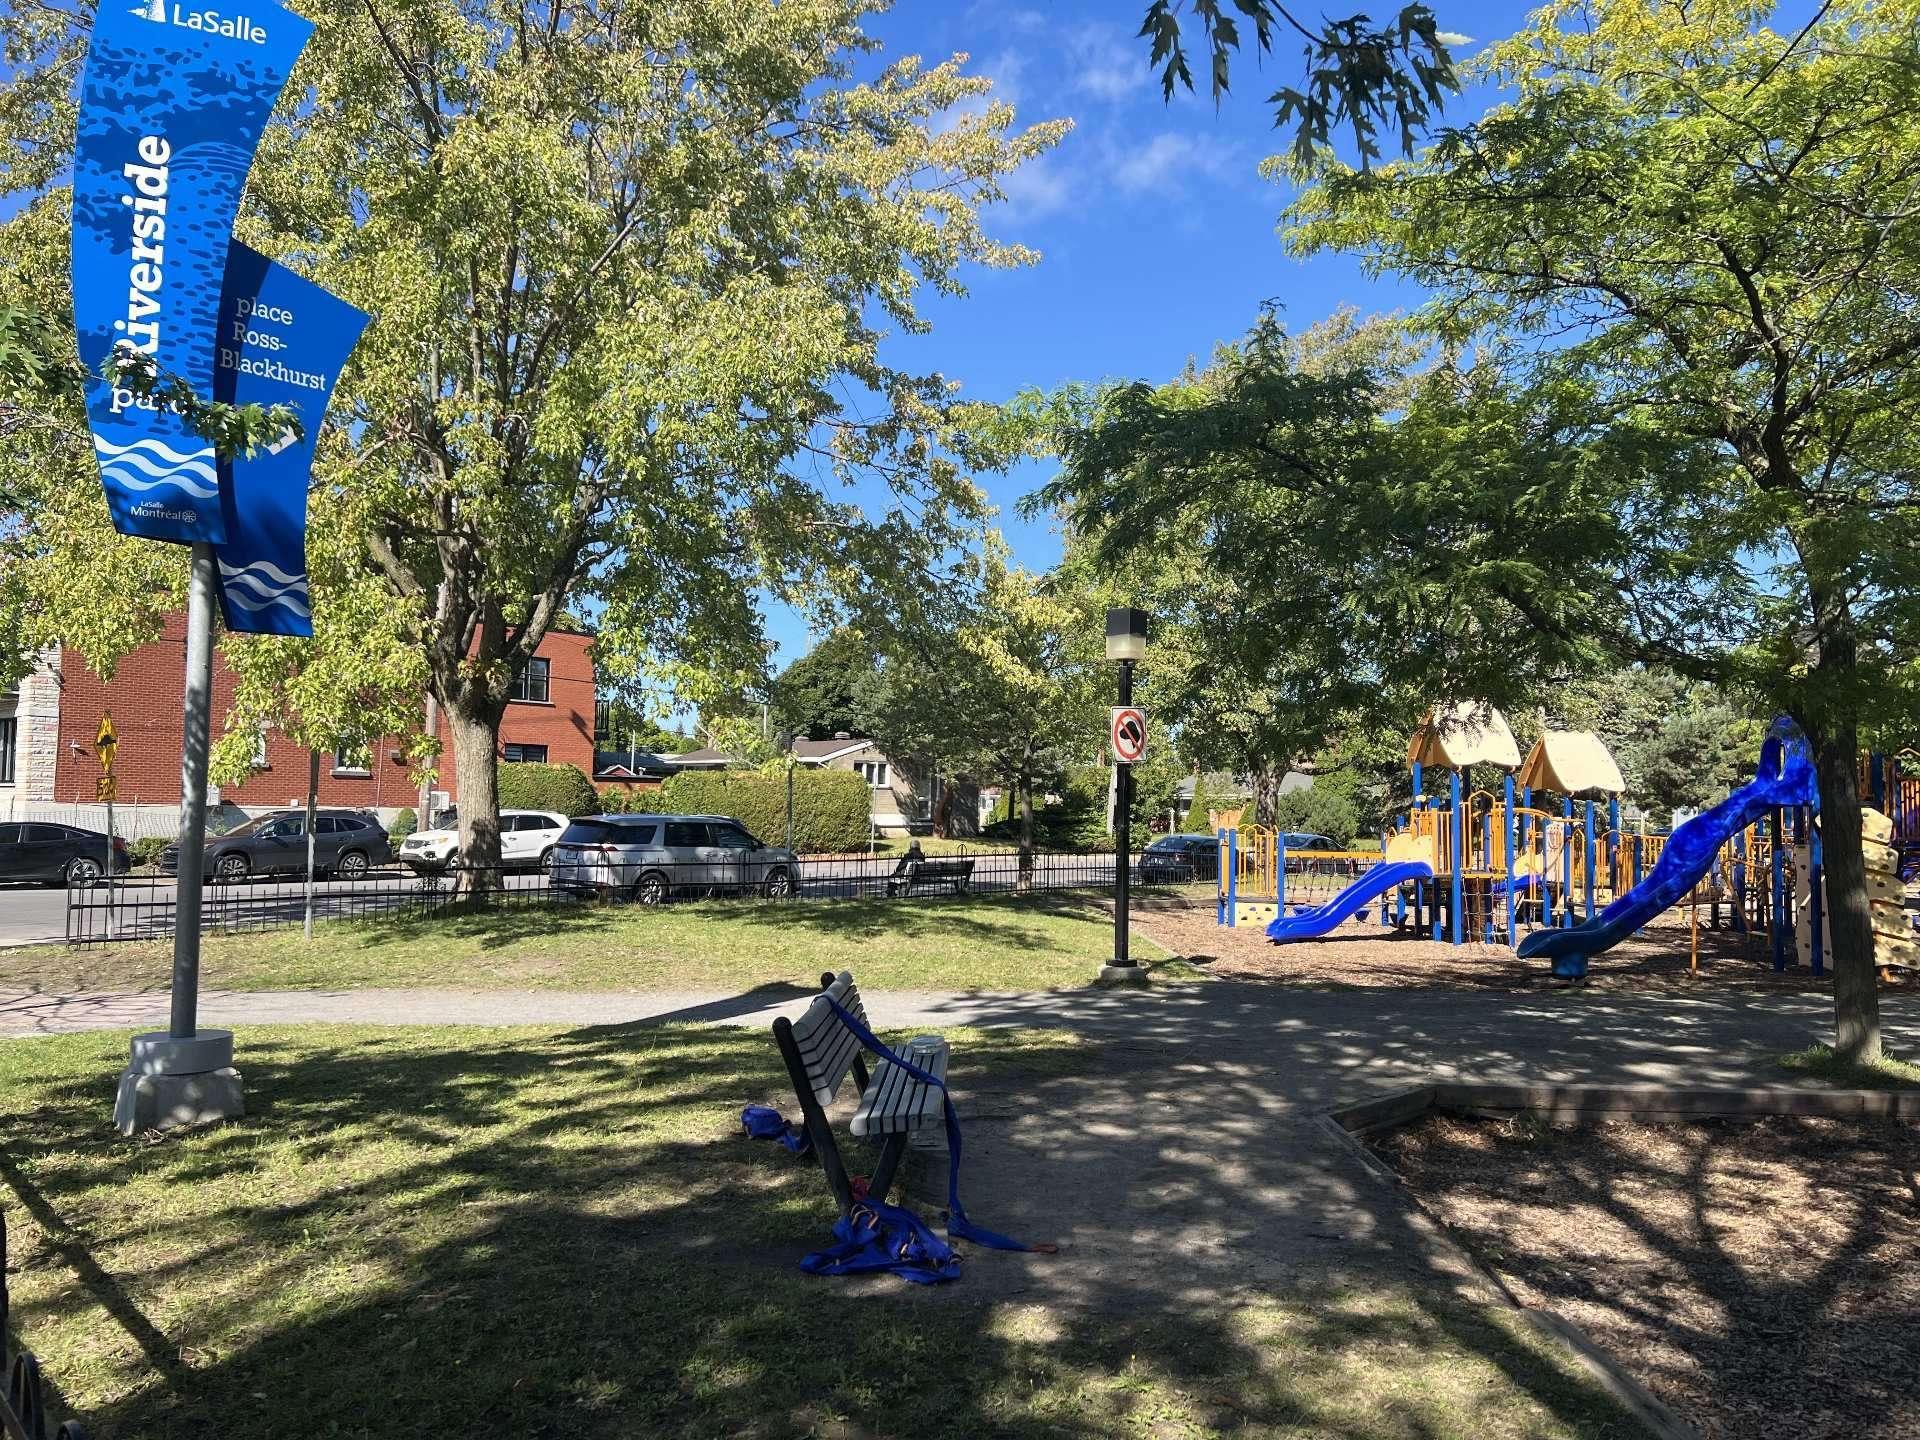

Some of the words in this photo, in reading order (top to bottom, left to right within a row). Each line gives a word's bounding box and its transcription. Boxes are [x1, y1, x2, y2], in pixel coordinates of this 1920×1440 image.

[173, 3, 267, 45] LaSalle
[235, 297, 294, 326] place
[232, 321, 288, 351] Ross-
[219, 347, 326, 391] Blackhurst
